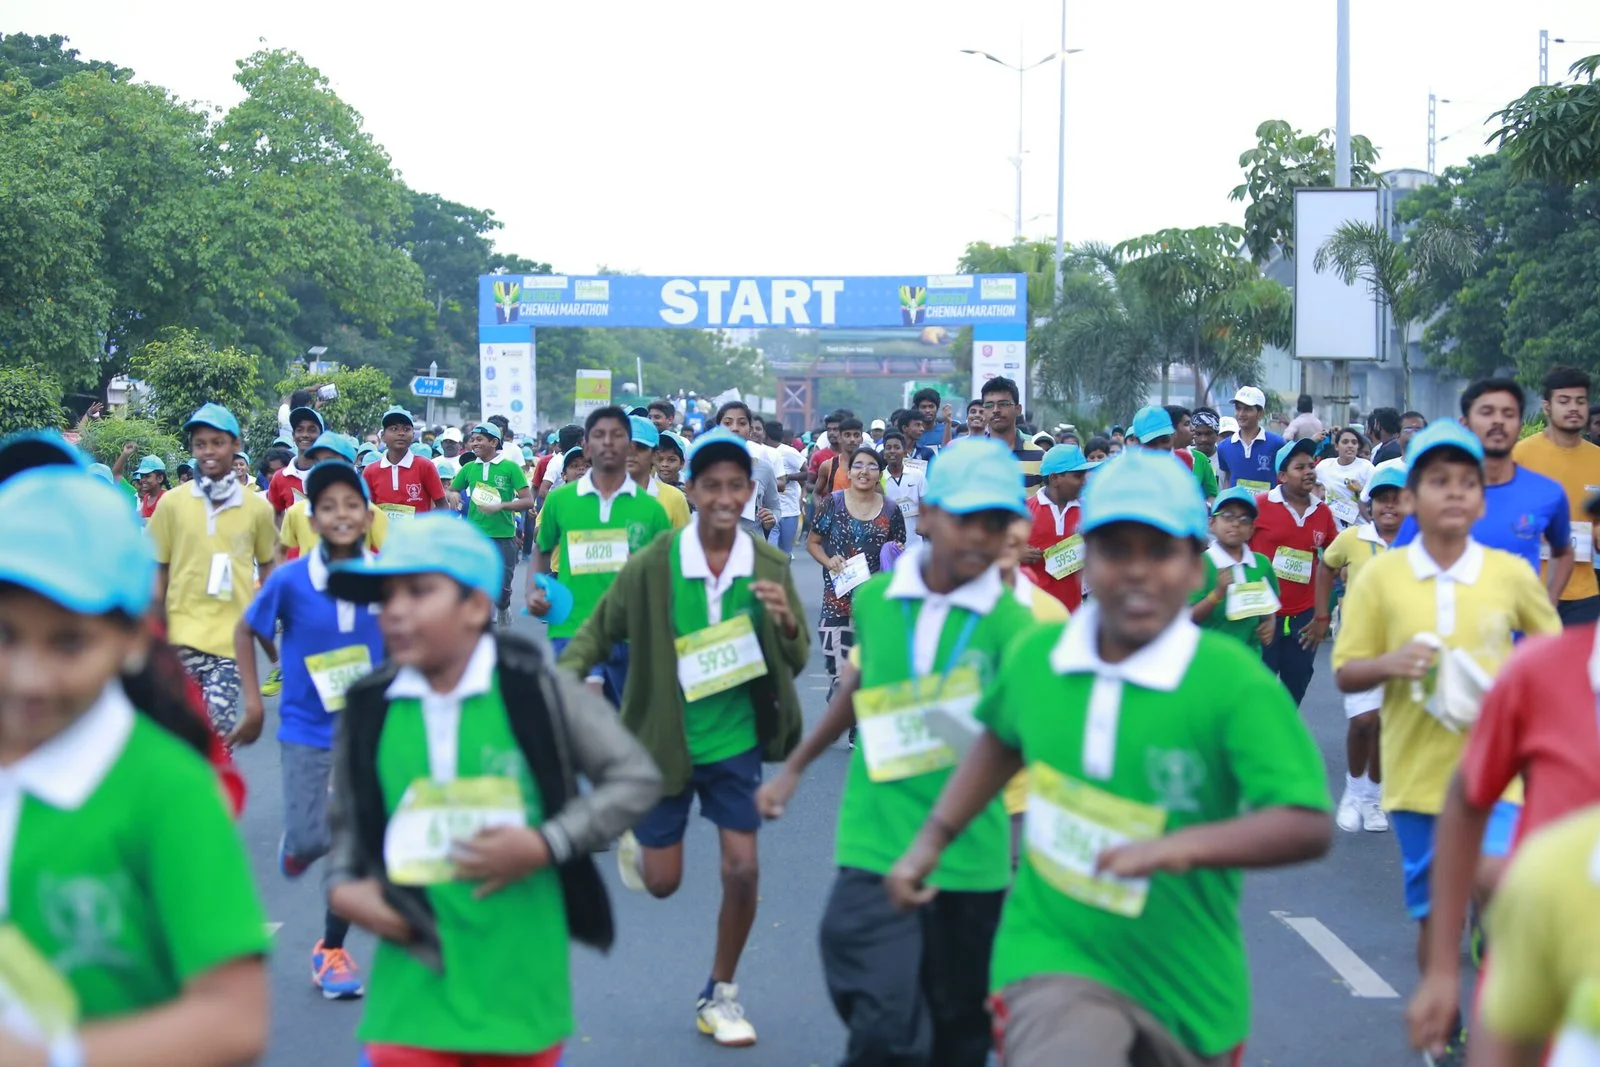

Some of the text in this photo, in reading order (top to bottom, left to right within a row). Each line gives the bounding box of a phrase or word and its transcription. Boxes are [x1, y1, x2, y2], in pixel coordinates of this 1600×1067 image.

[520, 303, 609, 316] CHENNAI MARATHON
[659, 279, 844, 325] START
[926, 304, 1017, 318] CHENNAI MARATHON
[585, 543, 613, 559] 6828
[1055, 549, 1077, 567] 5953
[1284, 558, 1304, 573] 5985
[698, 643, 738, 674] 5933
